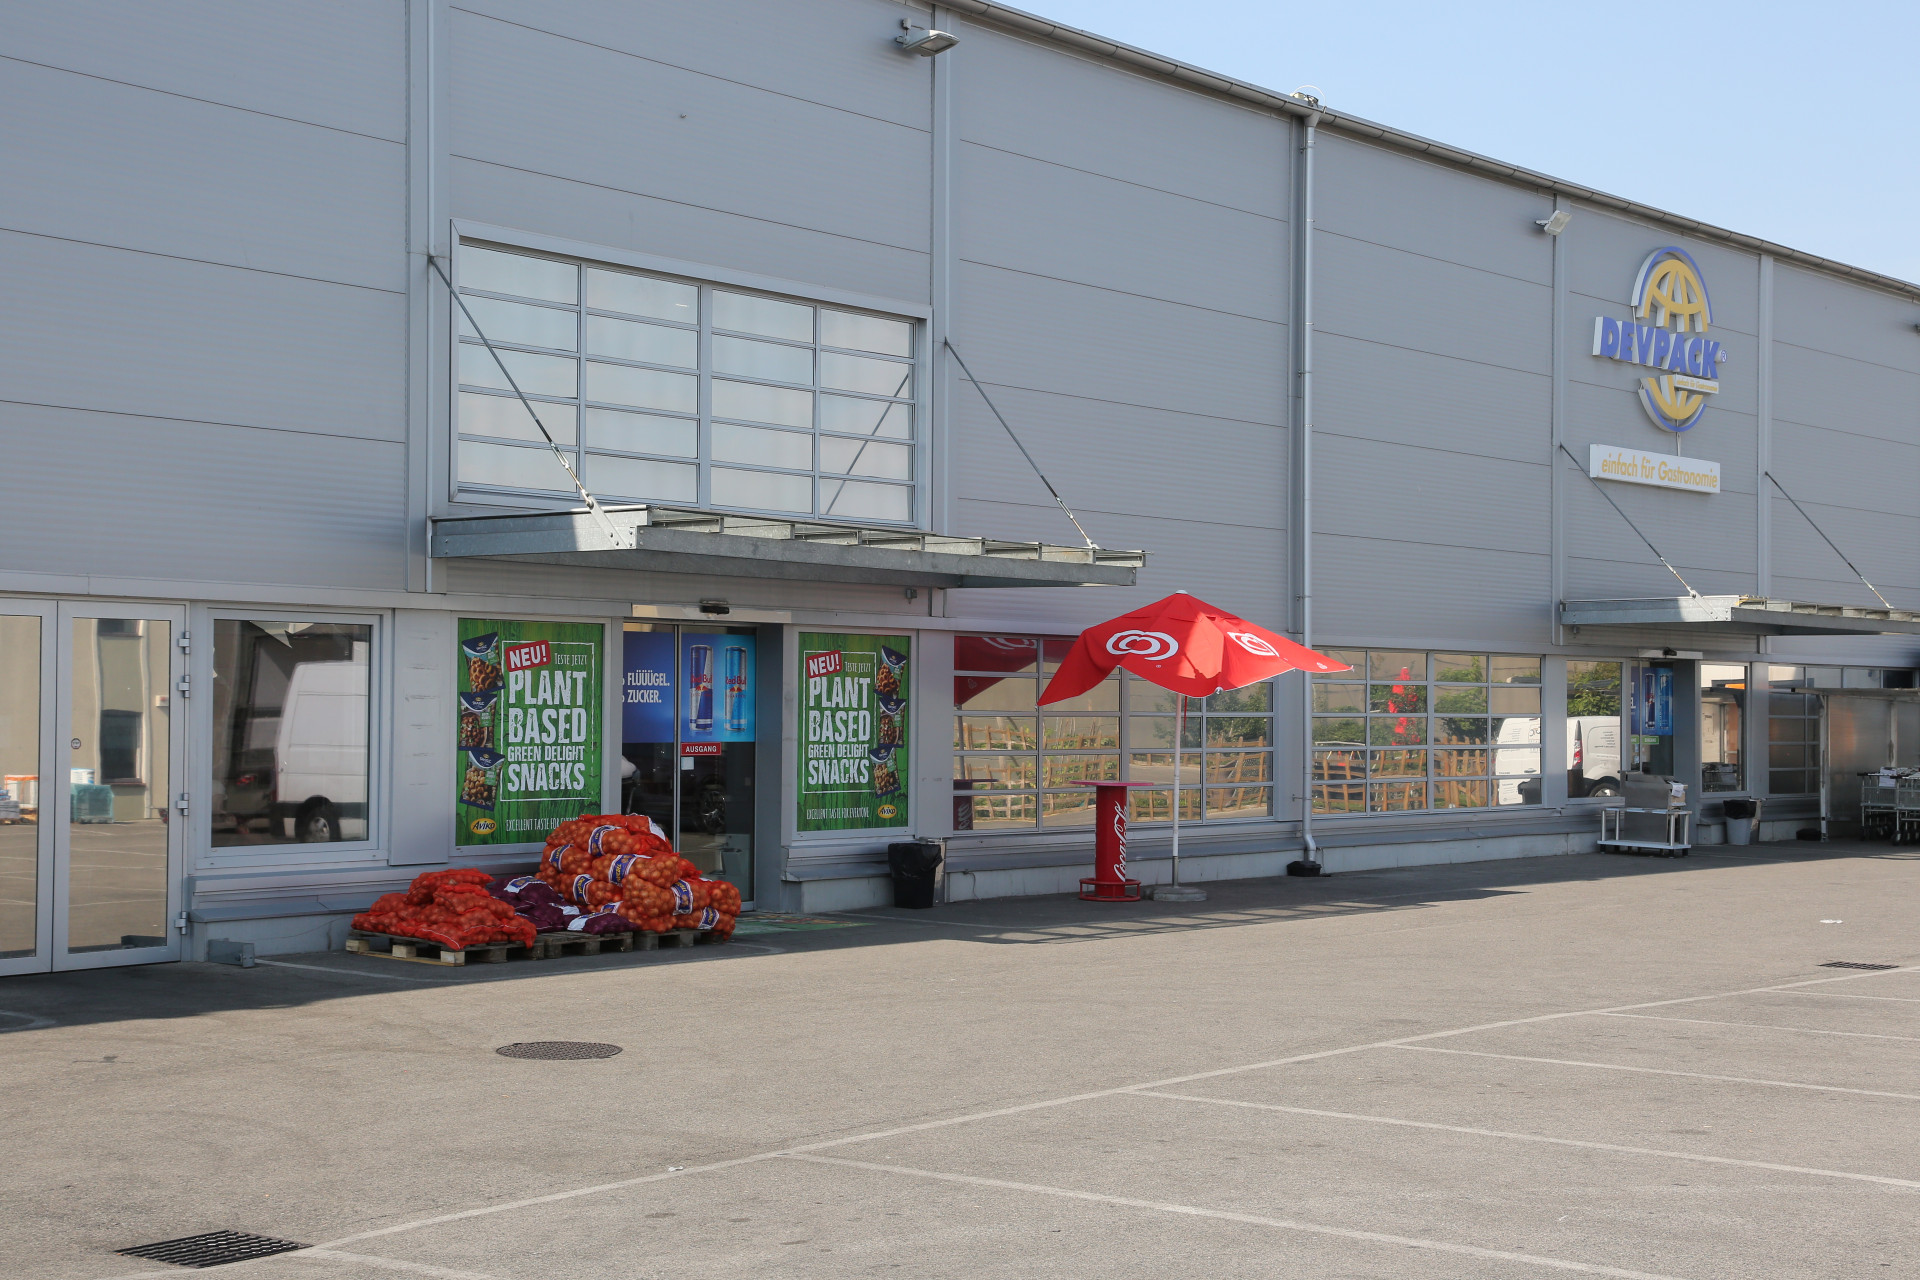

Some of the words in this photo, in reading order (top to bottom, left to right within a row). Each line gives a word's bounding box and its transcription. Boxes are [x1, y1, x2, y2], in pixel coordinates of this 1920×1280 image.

[1599, 316, 1720, 379] DEVPACK
[1602, 453, 1638, 477] einfach
[1641, 457, 1655, 479] für
[1658, 461, 1718, 488] Gastronomie
[509, 644, 547, 669] NEU!
[809, 654, 840, 676] NEU!
[508, 670, 587, 706] PLANT
[627, 669, 670, 686] FLÜÜÜGEL.
[627, 689, 662, 703] ZUCKER.
[809, 677, 870, 708] PLANT
[508, 707, 587, 744] BASED
[809, 710, 870, 742] BASED
[507, 746, 541, 762] GREEN
[544, 745, 585, 761] DELIGHT
[808, 744, 835, 758] GREEN
[837, 744, 869, 758] DELIGHT
[507, 762, 586, 792] SNACKS
[808, 759, 870, 785] SNACKS
[506, 819, 533, 831] EXCELLENT
[534, 818, 549, 831] TASTE
